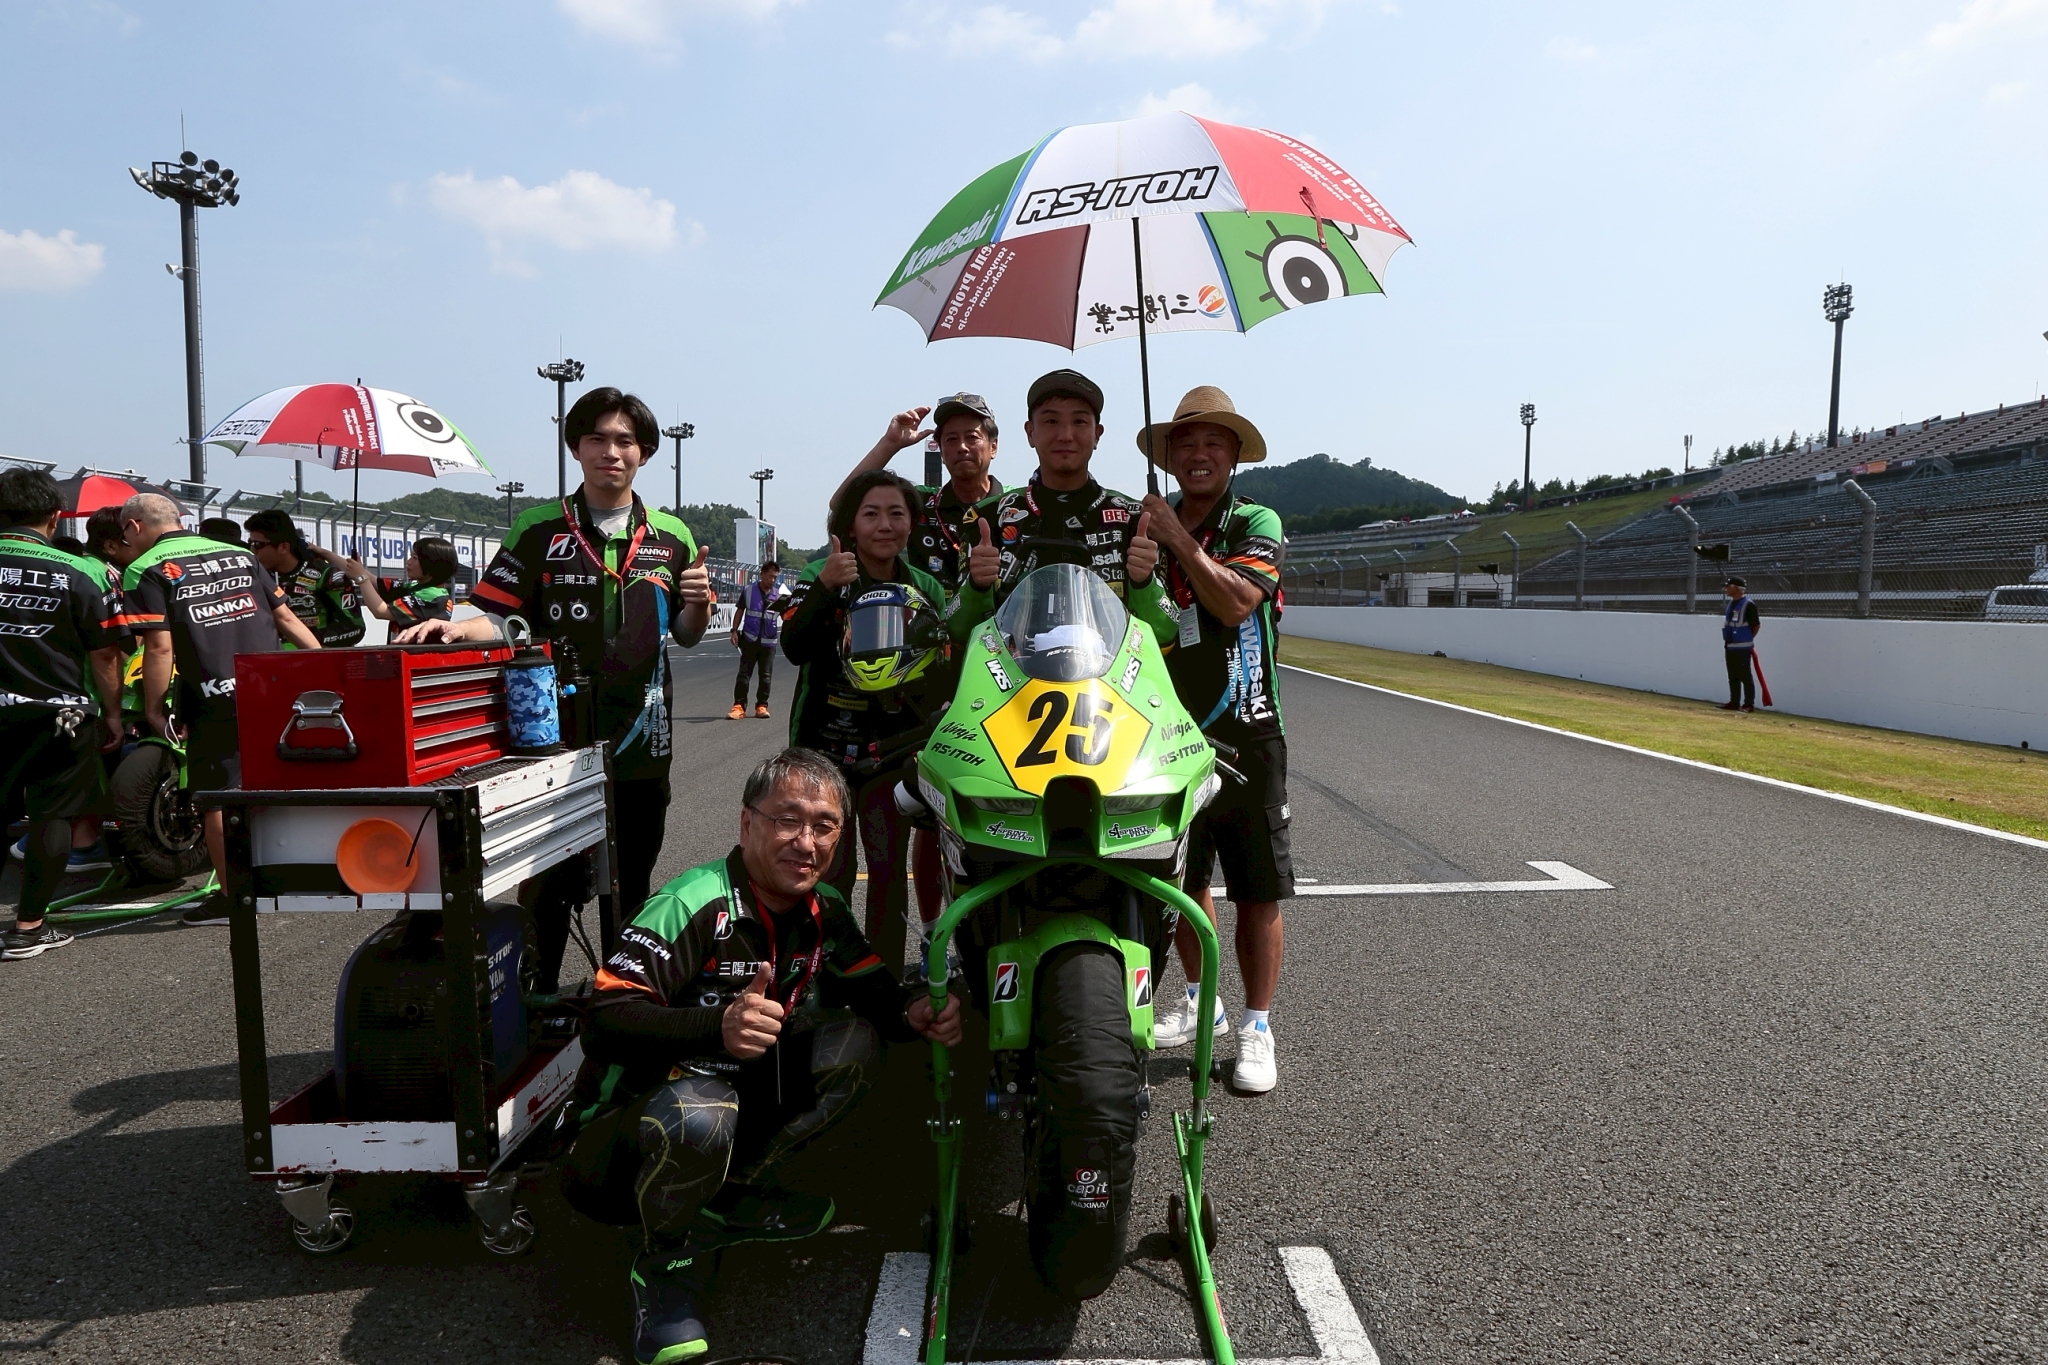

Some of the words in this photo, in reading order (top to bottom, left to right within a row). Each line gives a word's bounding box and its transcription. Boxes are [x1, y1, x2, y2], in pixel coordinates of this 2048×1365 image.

[1016, 165, 1219, 225] RS-ITOH
[1342, 177, 1398, 229] Project
[897, 204, 1000, 283] Kawasaki
[40, 551, 74, 563] Project
[636, 548, 669, 557] NANKAI
[186, 555, 252, 577] 三陽工業
[492, 567, 519, 584] Ninja
[554, 574, 597, 585] 三陽工業
[861, 592, 888, 601] SHOEI
[194, 596, 253, 619] NANKAI
[204, 619, 221, 627] Always
[1226, 648, 1237, 702] rs-itoh.com
[1232, 647, 1251, 723] sanyou-ind.co.jp
[201, 678, 236, 698] Ka
[940, 721, 977, 741] Ninja
[1015, 691, 1113, 768] 25
[1161, 719, 1194, 741] Ninja
[608, 952, 645, 974] Ninja
[719, 961, 762, 977] 三陽工
[1067, 1182, 1108, 1197] capit
[1071, 1200, 1106, 1209] MAXIMA
[676, 1257, 693, 1268] asics
